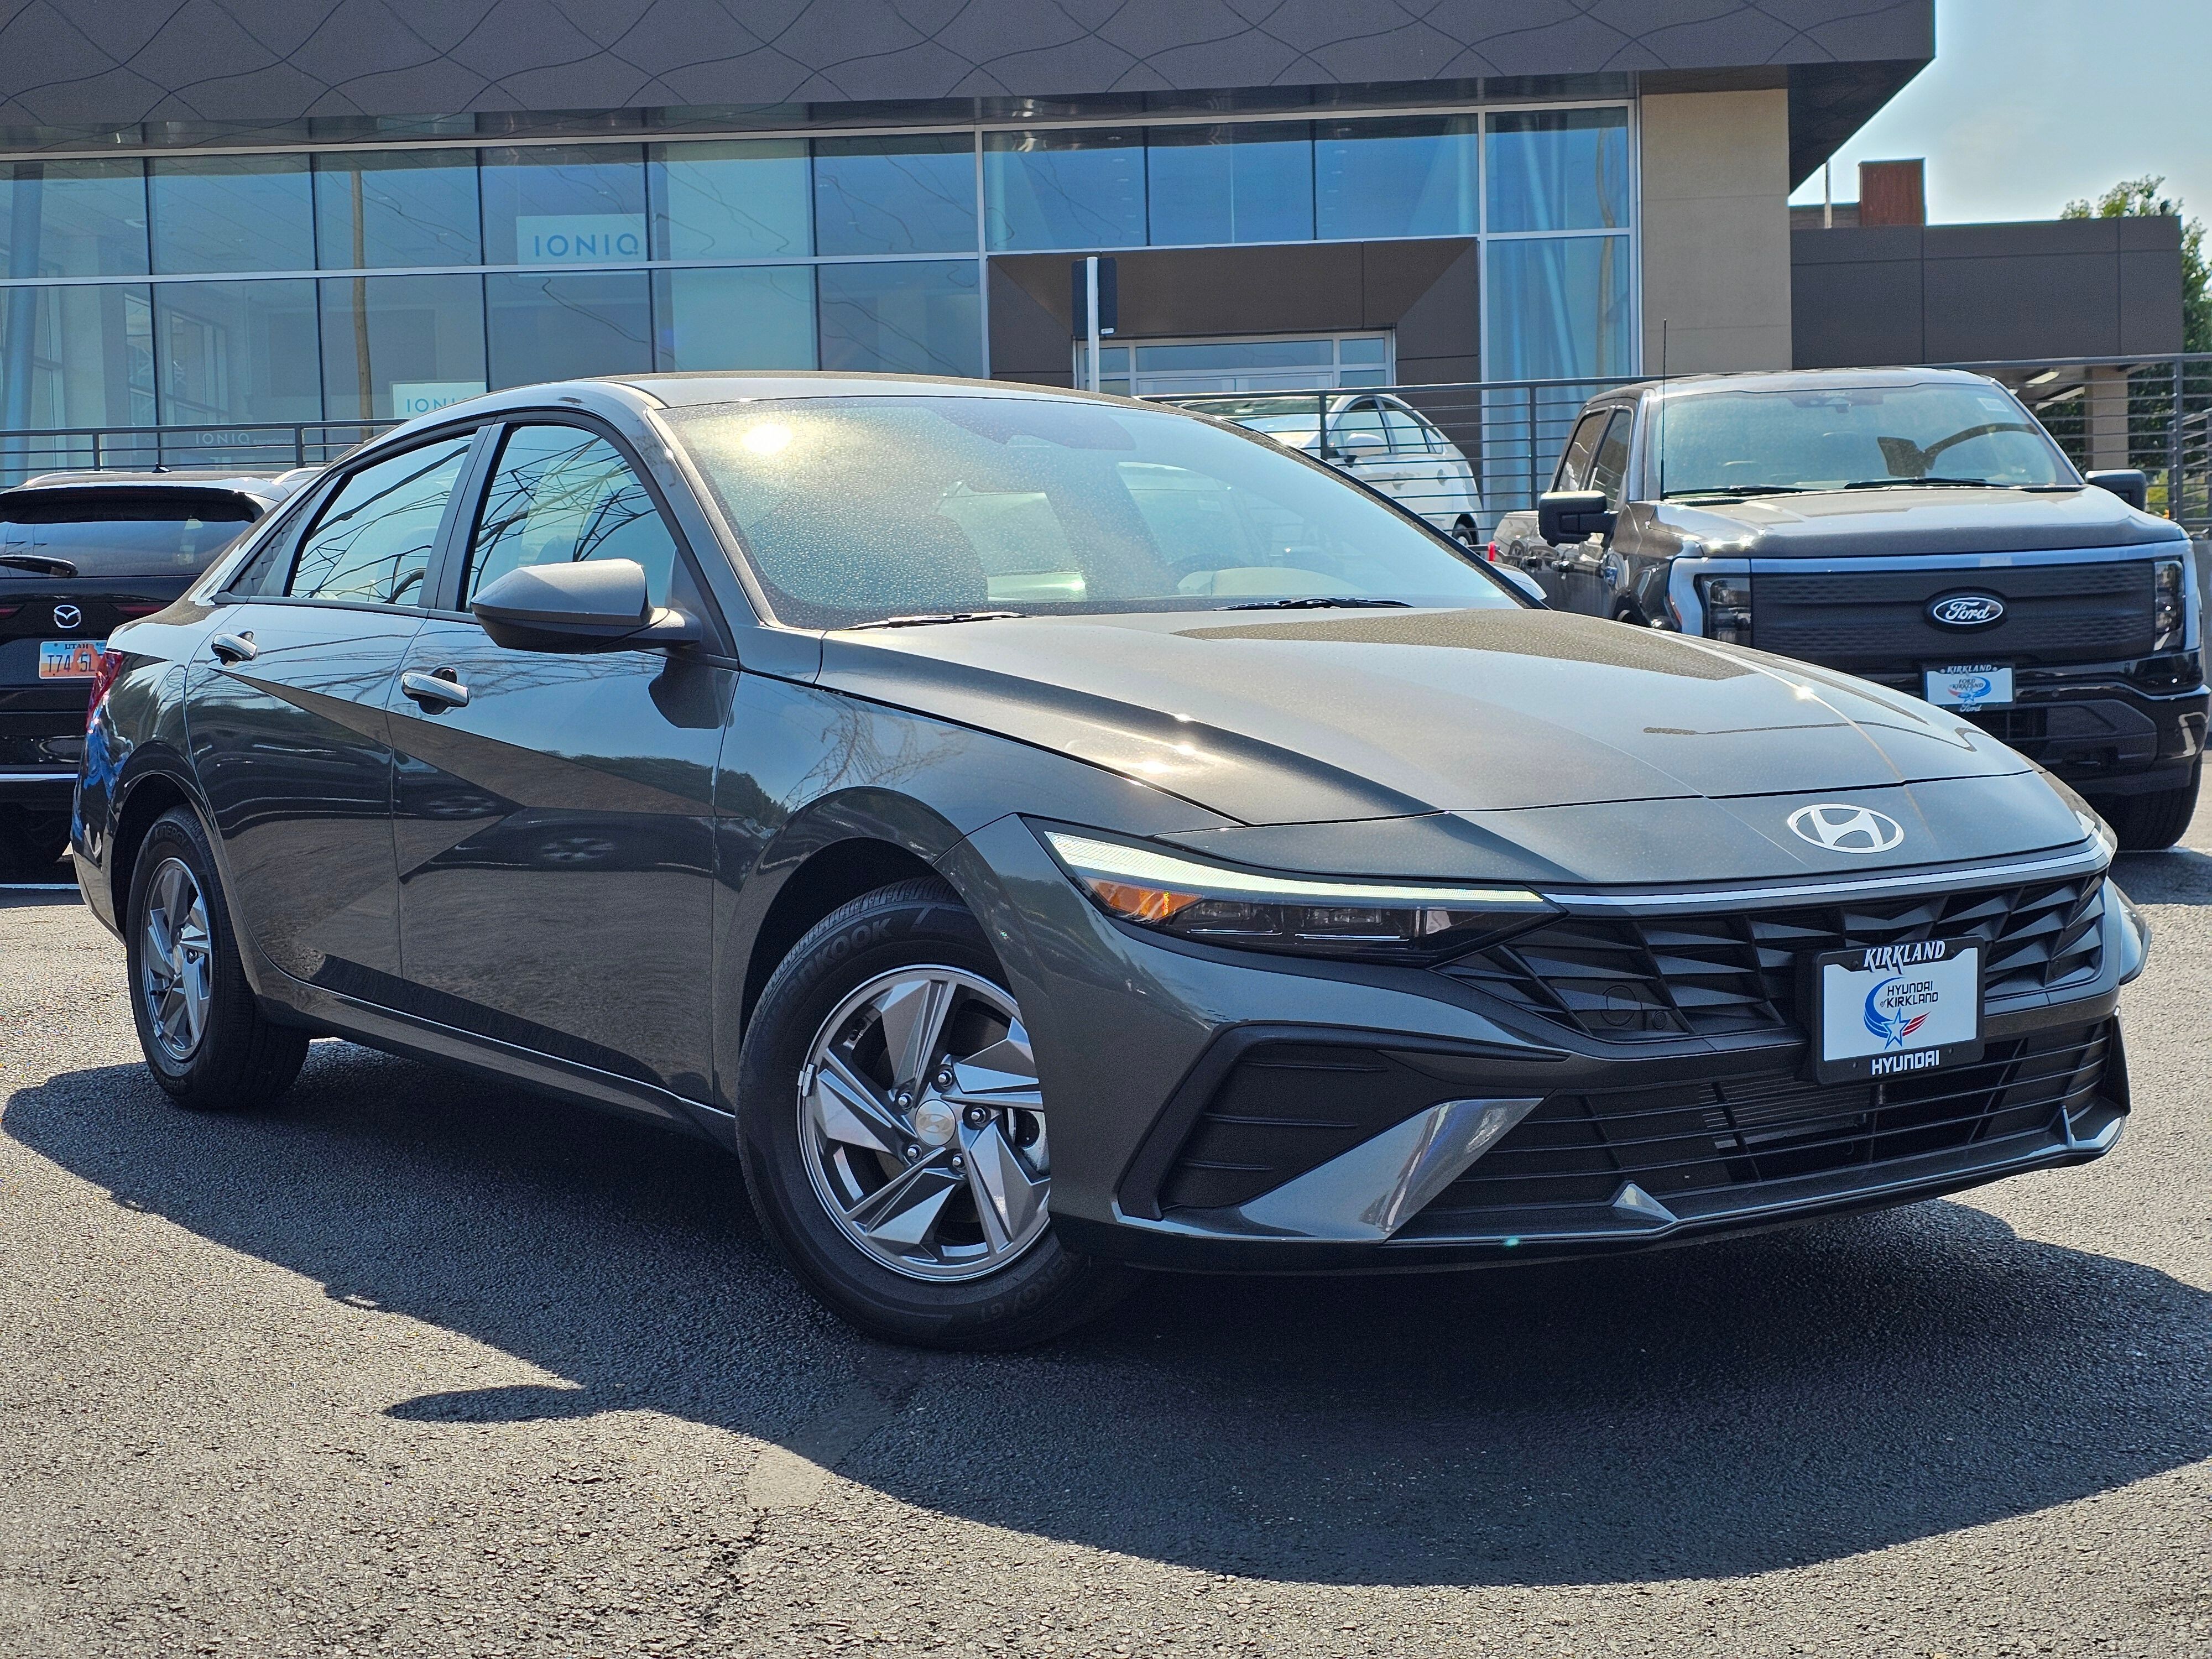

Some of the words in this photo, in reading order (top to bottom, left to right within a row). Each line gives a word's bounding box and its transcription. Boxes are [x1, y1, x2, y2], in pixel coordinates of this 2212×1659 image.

[535, 233, 639, 257] IONIQ
[196, 432, 251, 445] IONIQ
[1945, 601, 1990, 620] Ford
[48, 655, 71, 672] T74
[1947, 664, 1992, 676] KIRKLAND
[1959, 703, 1983, 712] Ford
[1863, 941, 1945, 974] KIRKLAND
[1887, 980, 1933, 997] HYUNDAI
[1880, 999, 1887, 1008] of
[1886, 992, 1938, 1008] KIRKLAND
[1871, 1050, 1940, 1076] HYUNDAI
